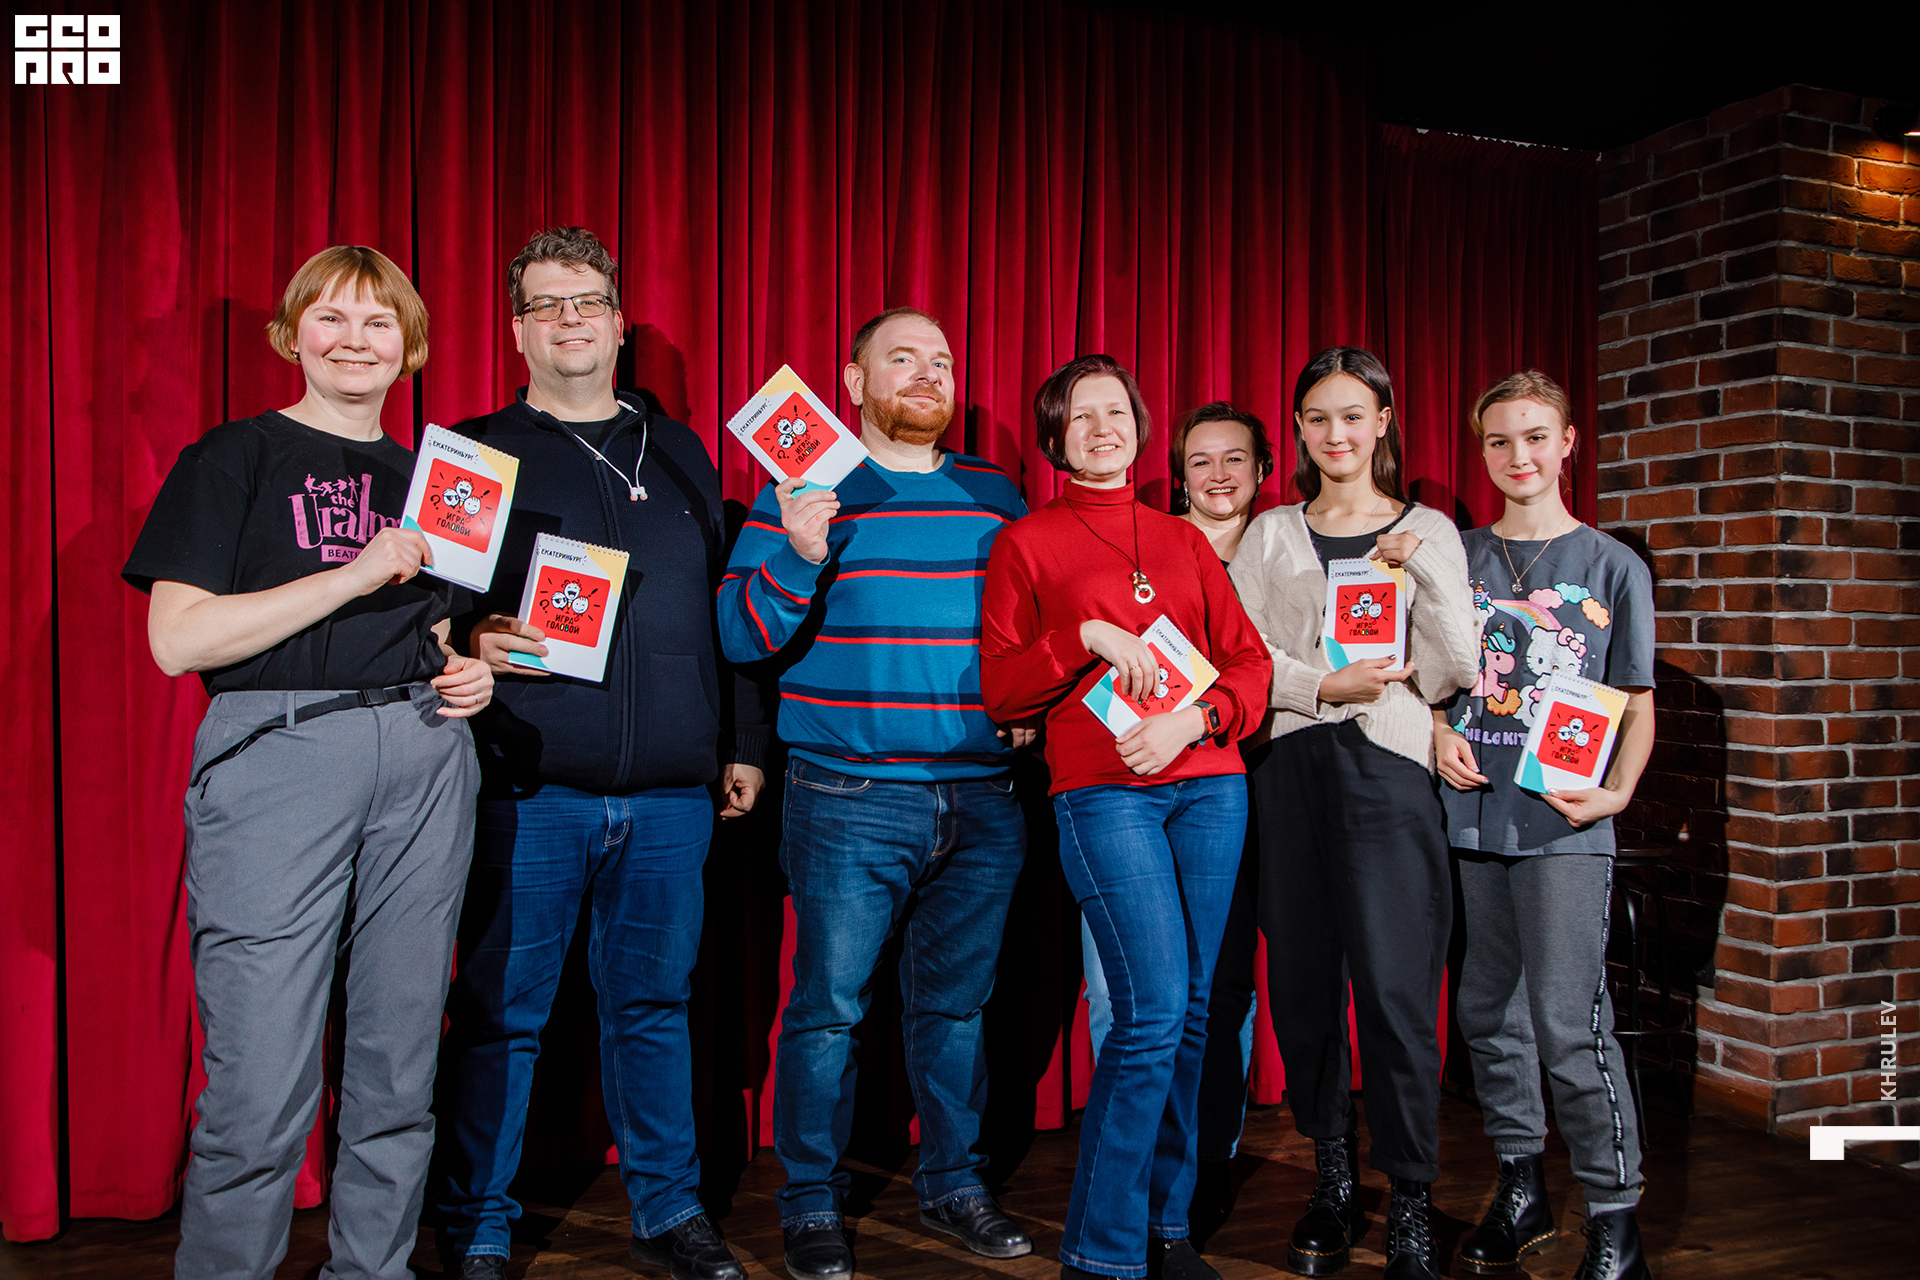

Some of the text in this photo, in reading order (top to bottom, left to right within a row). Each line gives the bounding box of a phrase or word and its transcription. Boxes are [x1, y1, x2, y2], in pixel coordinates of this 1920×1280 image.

[740, 403, 768, 432] ЕКАТЕРИНБУРГ
[433, 441, 474, 460] ЕКАТЕРИНБУРГ
[795, 441, 811, 454] ИГРА
[796, 440, 820, 464] ГОЛОВОЙ
[330, 493, 355, 508] the
[288, 473, 402, 549] Uralm
[446, 512, 465, 525] ИГРА
[437, 519, 470, 536] ГОЛОВОЙ
[542, 549, 581, 562] ЕКАТЕРИНБУРГ
[555, 614, 573, 625] ИГРА
[546, 621, 579, 633] ГОЛОВОЙ
[1551, 751, 1579, 764] ГОЛОВОЙ
